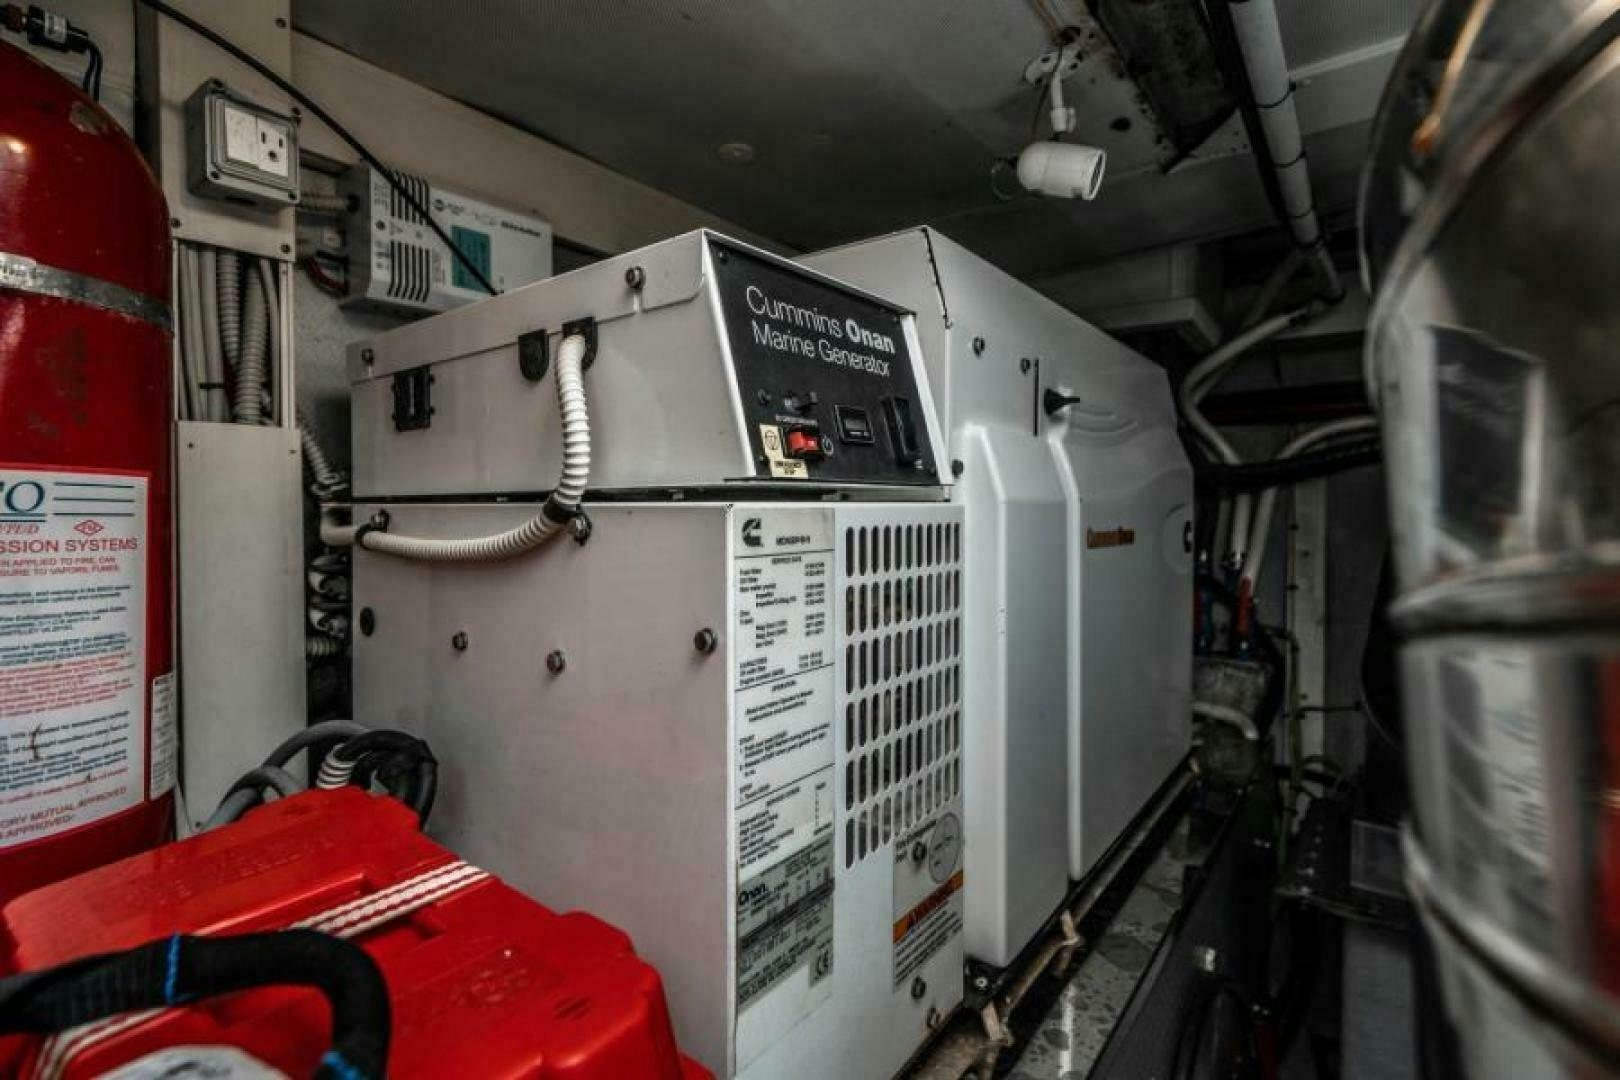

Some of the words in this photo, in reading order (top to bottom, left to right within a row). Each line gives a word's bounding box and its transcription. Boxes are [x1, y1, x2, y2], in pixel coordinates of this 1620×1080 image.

[746, 285, 843, 339] Cummins
[845, 318, 896, 355] Onan
[751, 321, 816, 359] Marine
[818, 339, 891, 377] Generator
[65, 537, 138, 551] SYSTEMS
[29, 803, 74, 822] MUTUAL
